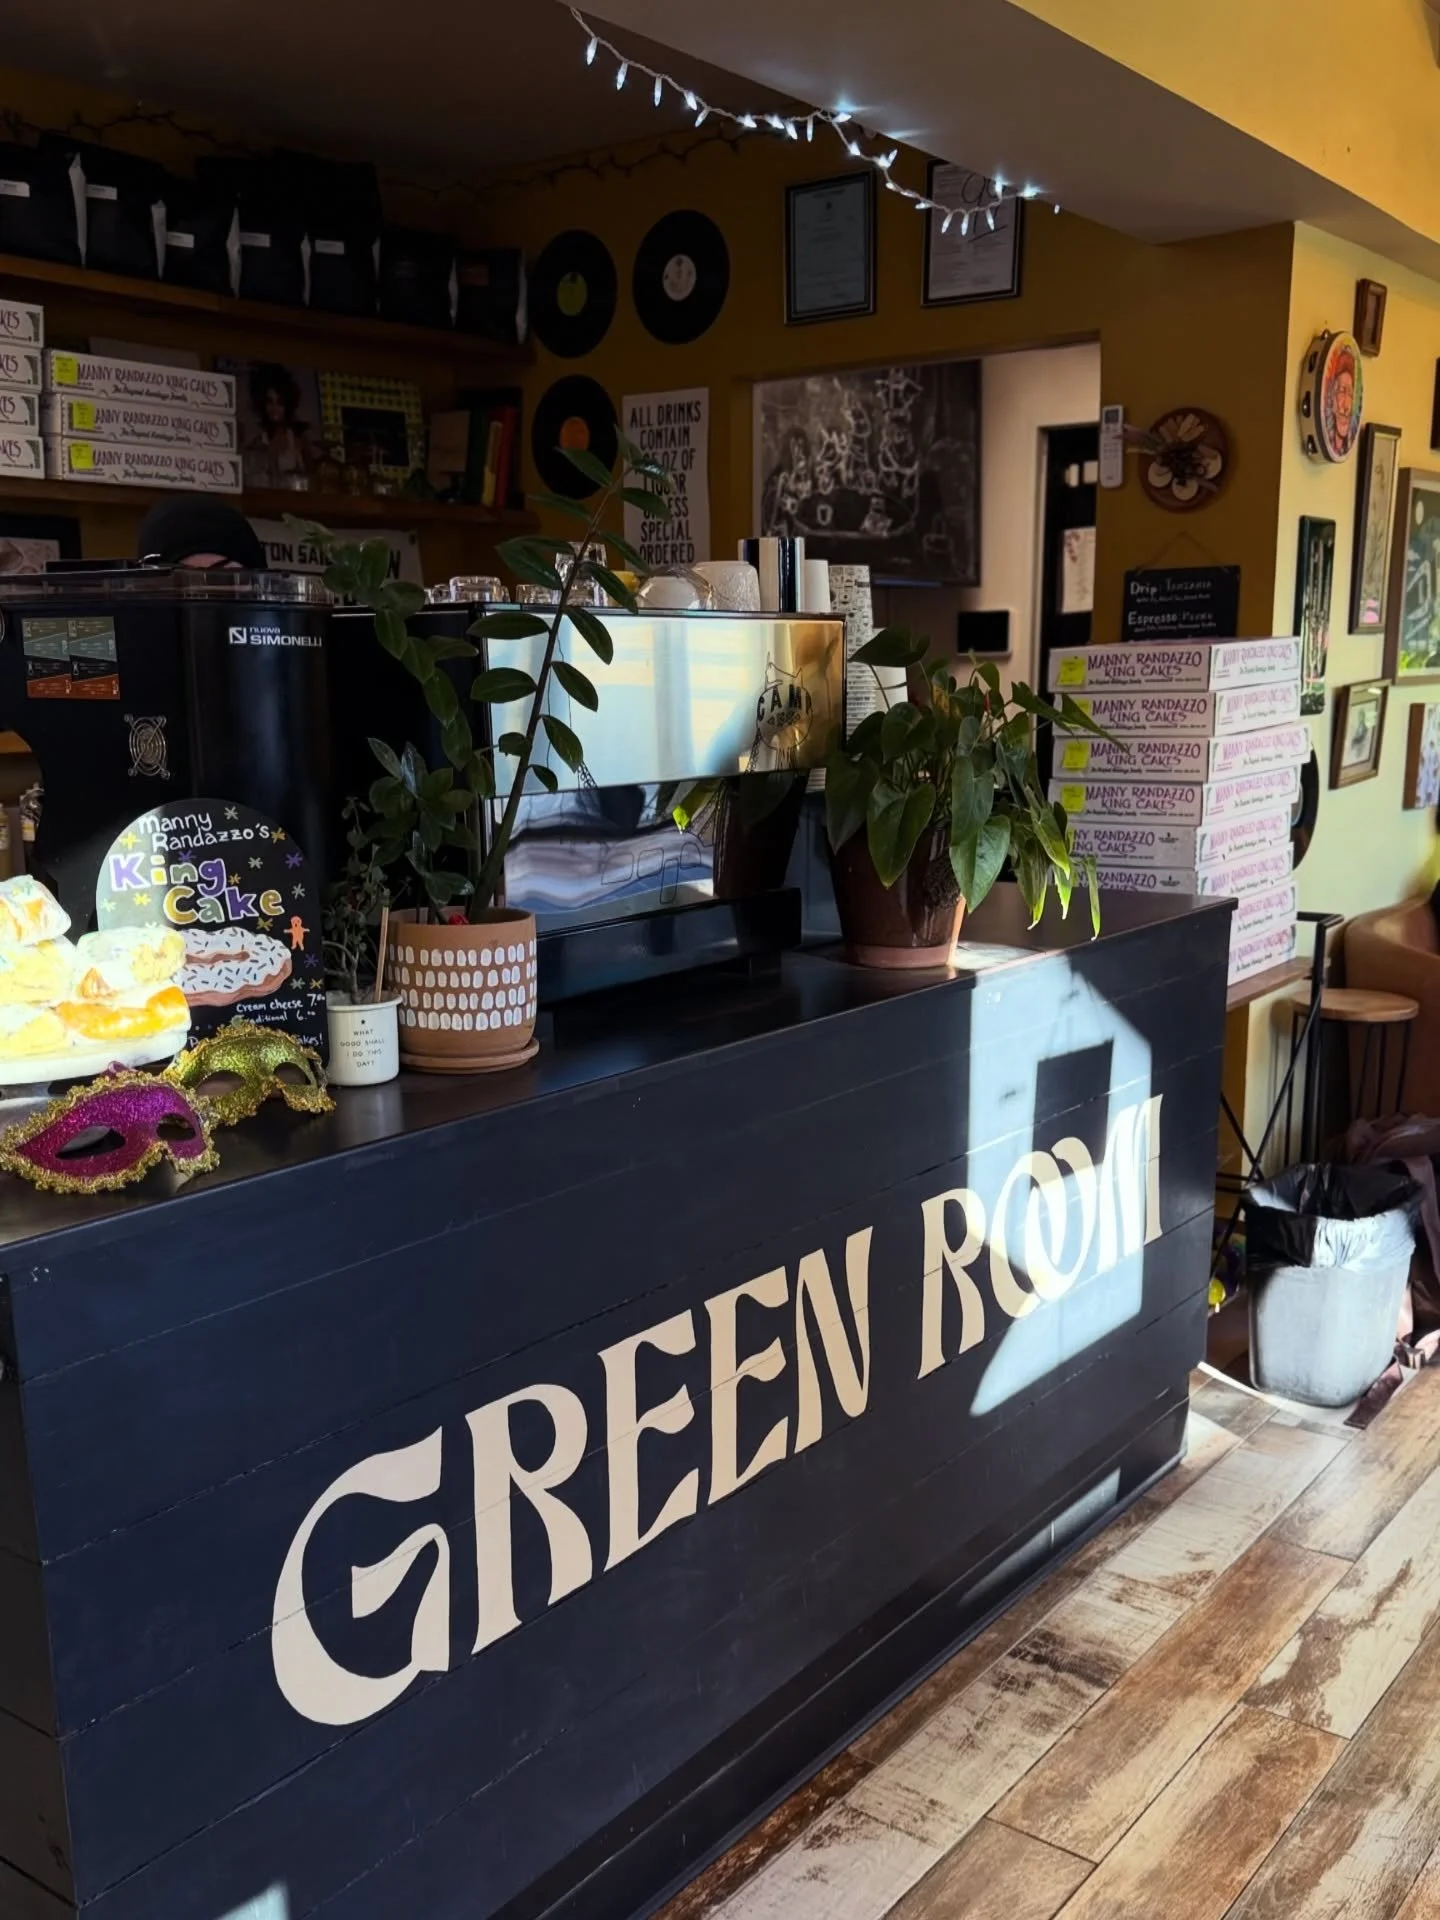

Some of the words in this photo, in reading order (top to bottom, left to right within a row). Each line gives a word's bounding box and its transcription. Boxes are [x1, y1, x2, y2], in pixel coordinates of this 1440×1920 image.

[115, 367, 163, 388] RANDAZZO
[166, 373, 188, 393] KING
[190, 377, 217, 402] CAKES
[630, 408, 653, 428] ALL
[657, 401, 702, 425] DRINKS
[95, 406, 120, 424] ANNY
[123, 411, 169, 429] RANDAZZO
[171, 416, 192, 434] KING
[193, 420, 219, 443] CAKES
[640, 426, 690, 450] CONTAIN
[681, 447, 697, 470] OF
[124, 453, 172, 471] RANDAZZO
[175, 458, 196, 475] KING
[197, 461, 225, 485] CAKES
[640, 519, 692, 542] SPECIAL
[640, 543, 695, 564] ORDERED
[249, 626, 281, 634] nuova
[250, 634, 322, 647] SIMONELLI
[1088, 653, 1132, 671] MANNY
[1137, 651, 1202, 668] RANDAZZO
[1105, 665, 1136, 679] KING
[1141, 664, 1182, 680] CAKES
[1093, 699, 1137, 716] MANNY
[1141, 698, 1207, 714] RANDAZZO
[1109, 712, 1140, 724] KING
[1145, 710, 1187, 727] CAKES
[1091, 742, 1133, 758] MANY
[1138, 742, 1201, 759] RANDAZZO
[1106, 755, 1137, 768] KING
[1141, 755, 1182, 771] CAKES
[1085, 785, 1128, 801] MANNY
[1132, 785, 1196, 804] RANDAZZO
[1102, 798, 1131, 811] KING
[1135, 798, 1176, 814] CAKES
[138, 812, 213, 835] Manny
[152, 823, 270, 853] Randazzo's
[1073, 840, 1093, 851] ING
[1097, 840, 1137, 854] CAKES
[1094, 829, 1156, 847] RANDAZZO
[109, 852, 227, 897] King
[1100, 871, 1157, 889] RANDAZZO
[163, 886, 285, 925] Cake
[236, 1003, 266, 1014] cream
[270, 999, 303, 1010] cheese
[353, 1028, 373, 1036] WHAT
[271, 1225, 874, 1726] GREEN
[917, 1093, 1163, 1381] ROOM
